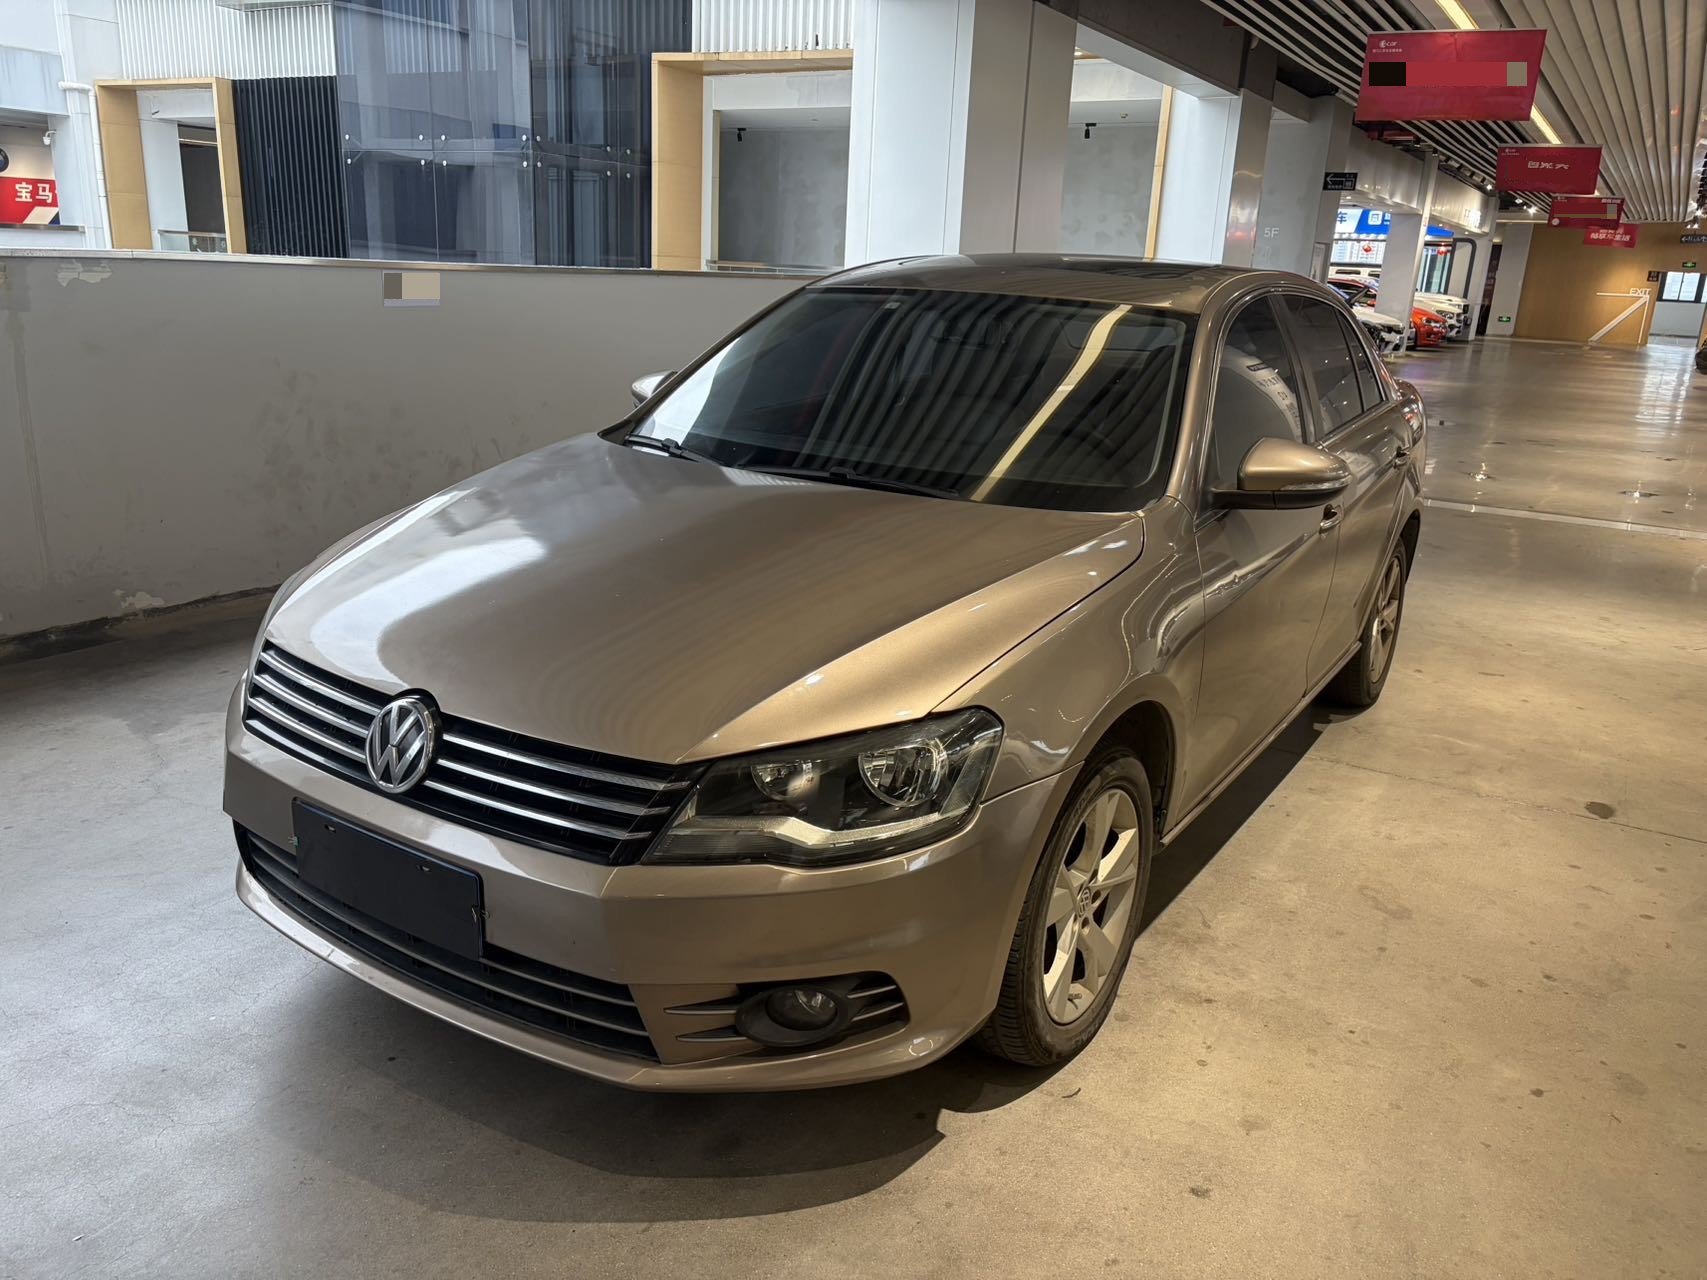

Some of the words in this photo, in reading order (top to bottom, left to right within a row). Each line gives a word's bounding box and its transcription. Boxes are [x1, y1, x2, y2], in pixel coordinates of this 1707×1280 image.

[15, 182, 52, 203] 宝马
[1264, 227, 1280, 238] 5F
[1629, 287, 1651, 296] EXIT
